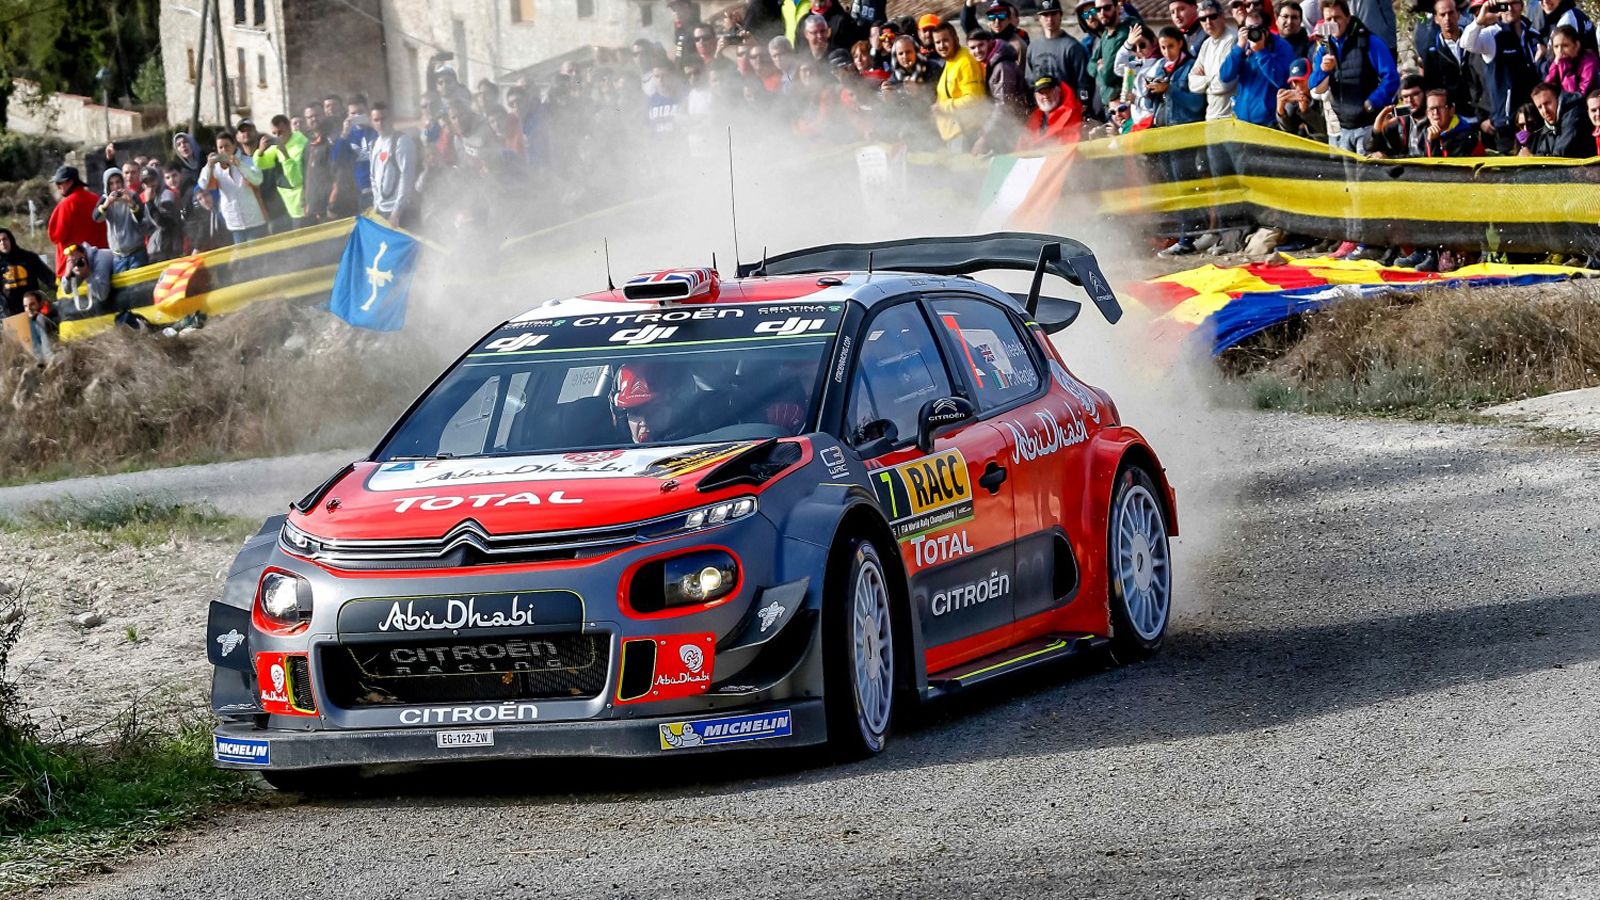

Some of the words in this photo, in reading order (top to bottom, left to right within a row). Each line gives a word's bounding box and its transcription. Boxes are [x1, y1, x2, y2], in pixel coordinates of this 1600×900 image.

[880, 471, 898, 518] 7
[907, 455, 965, 508] RACC
[391, 490, 584, 513] TOTAL
[704, 716, 789, 736] MICHELIN
[442, 732, 488, 744] EG-122-ZW
[218, 742, 268, 756] MICHELIN
